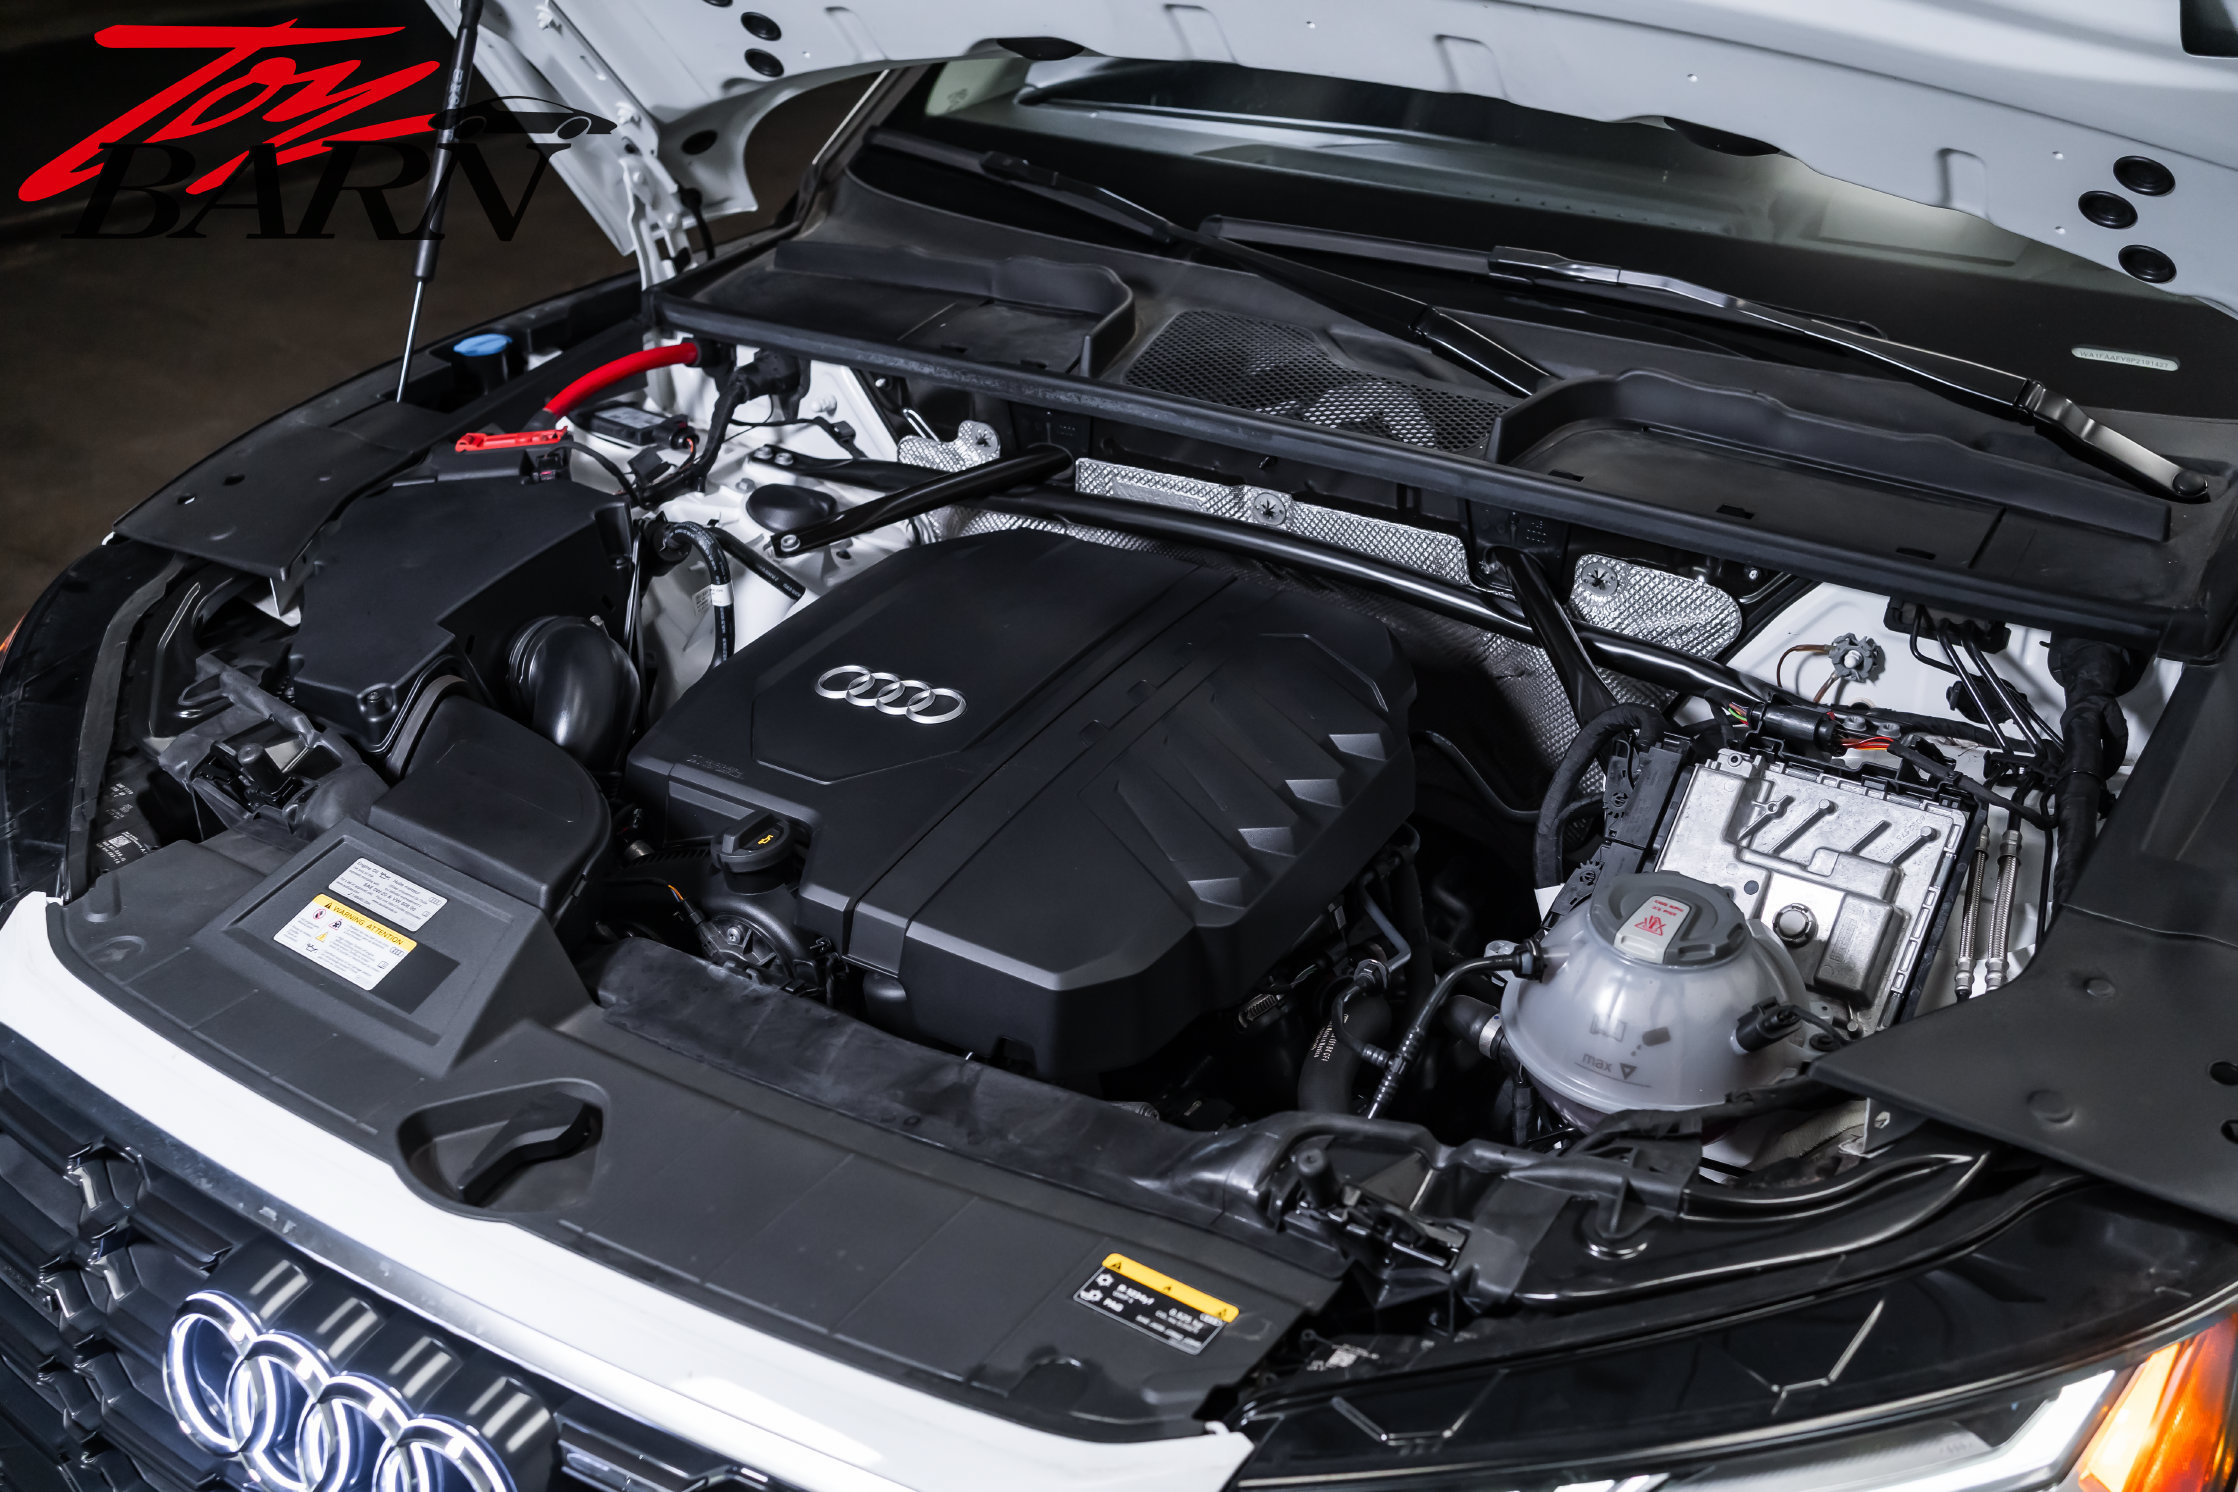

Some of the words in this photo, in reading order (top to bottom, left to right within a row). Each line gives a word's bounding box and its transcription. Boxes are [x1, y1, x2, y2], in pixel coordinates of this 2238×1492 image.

[333, 905, 364, 927] WARNING
[366, 922, 404, 946] ATTENTION
[1582, 1053, 1612, 1073] max
